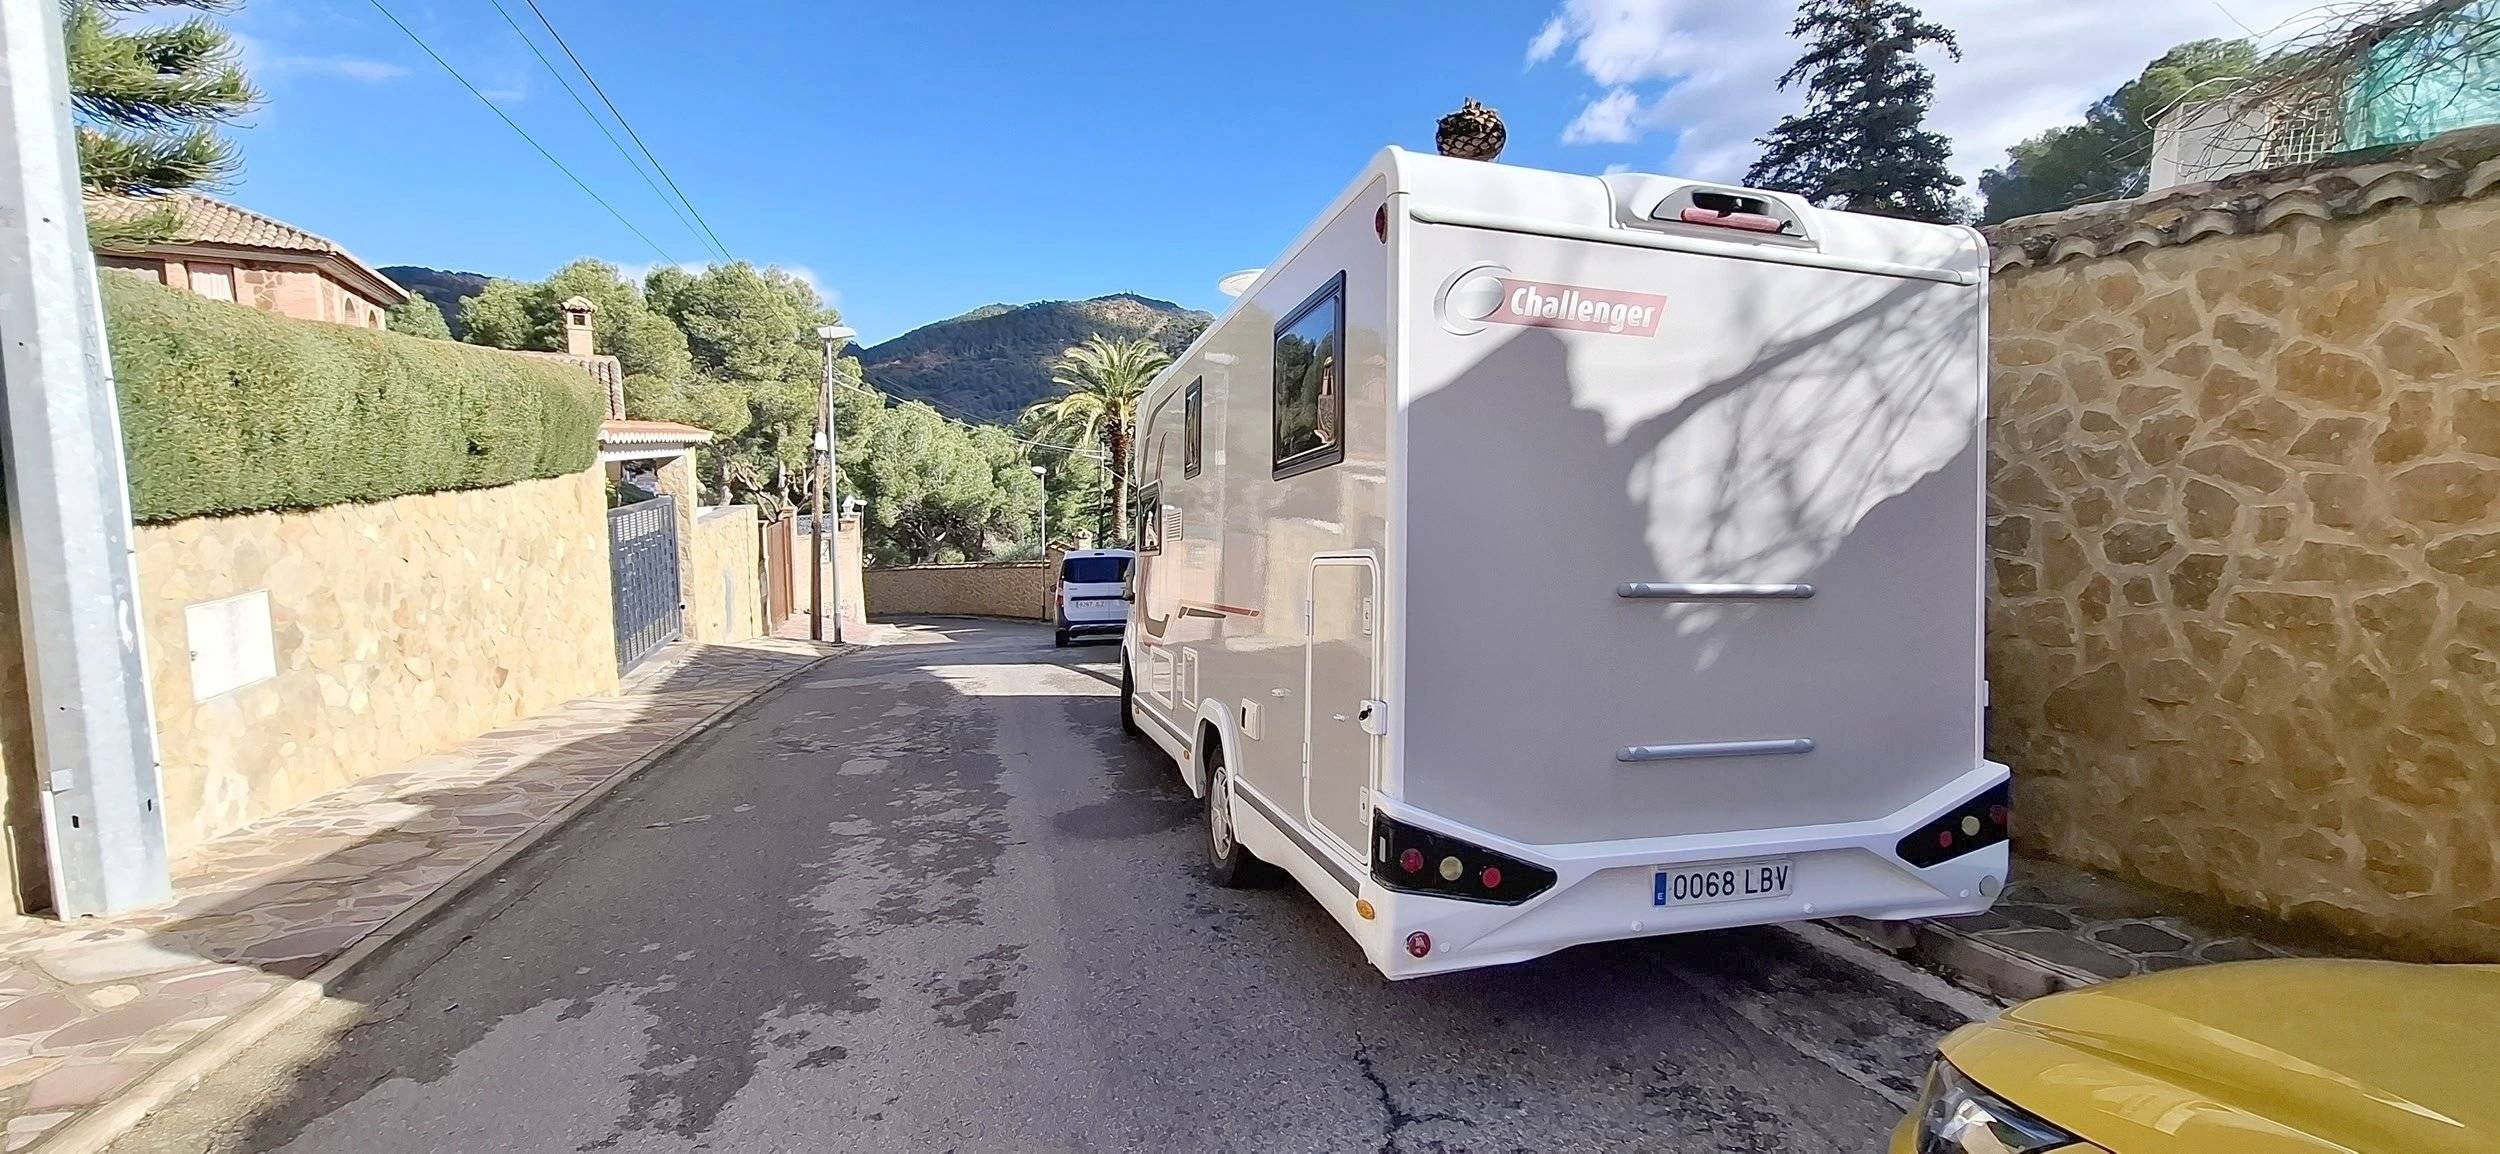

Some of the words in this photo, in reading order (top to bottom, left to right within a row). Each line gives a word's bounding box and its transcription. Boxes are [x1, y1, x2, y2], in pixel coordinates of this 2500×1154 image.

[1510, 286, 1656, 332] Challenger
[1673, 870, 1735, 900] 0068
[1745, 865, 1788, 894] LBV
